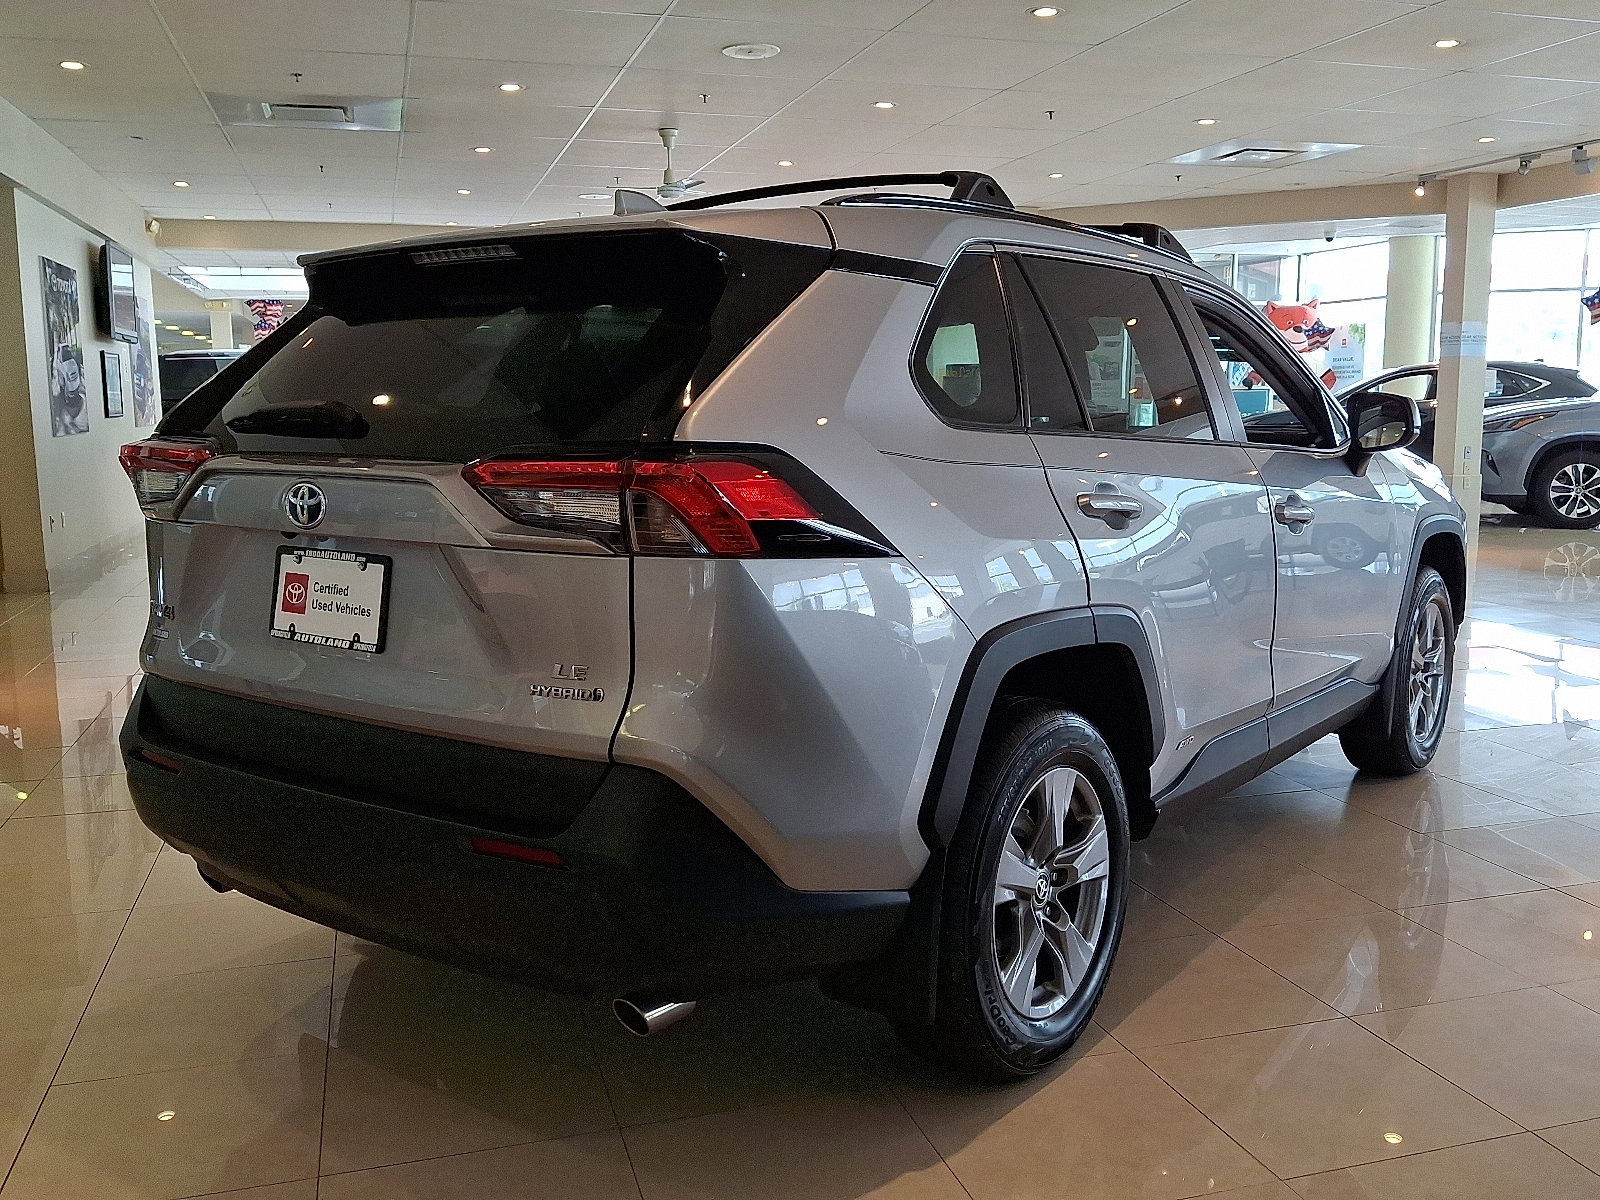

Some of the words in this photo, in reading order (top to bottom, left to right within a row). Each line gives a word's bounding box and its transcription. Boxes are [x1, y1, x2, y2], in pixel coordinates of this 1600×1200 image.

[313, 581, 350, 597] Certified
[312, 598, 333, 612] Used
[335, 601, 372, 618] Vehicles
[294, 632, 350, 649] AUTOLAND
[551, 663, 589, 681] LE
[530, 684, 592, 701] HYBRID
